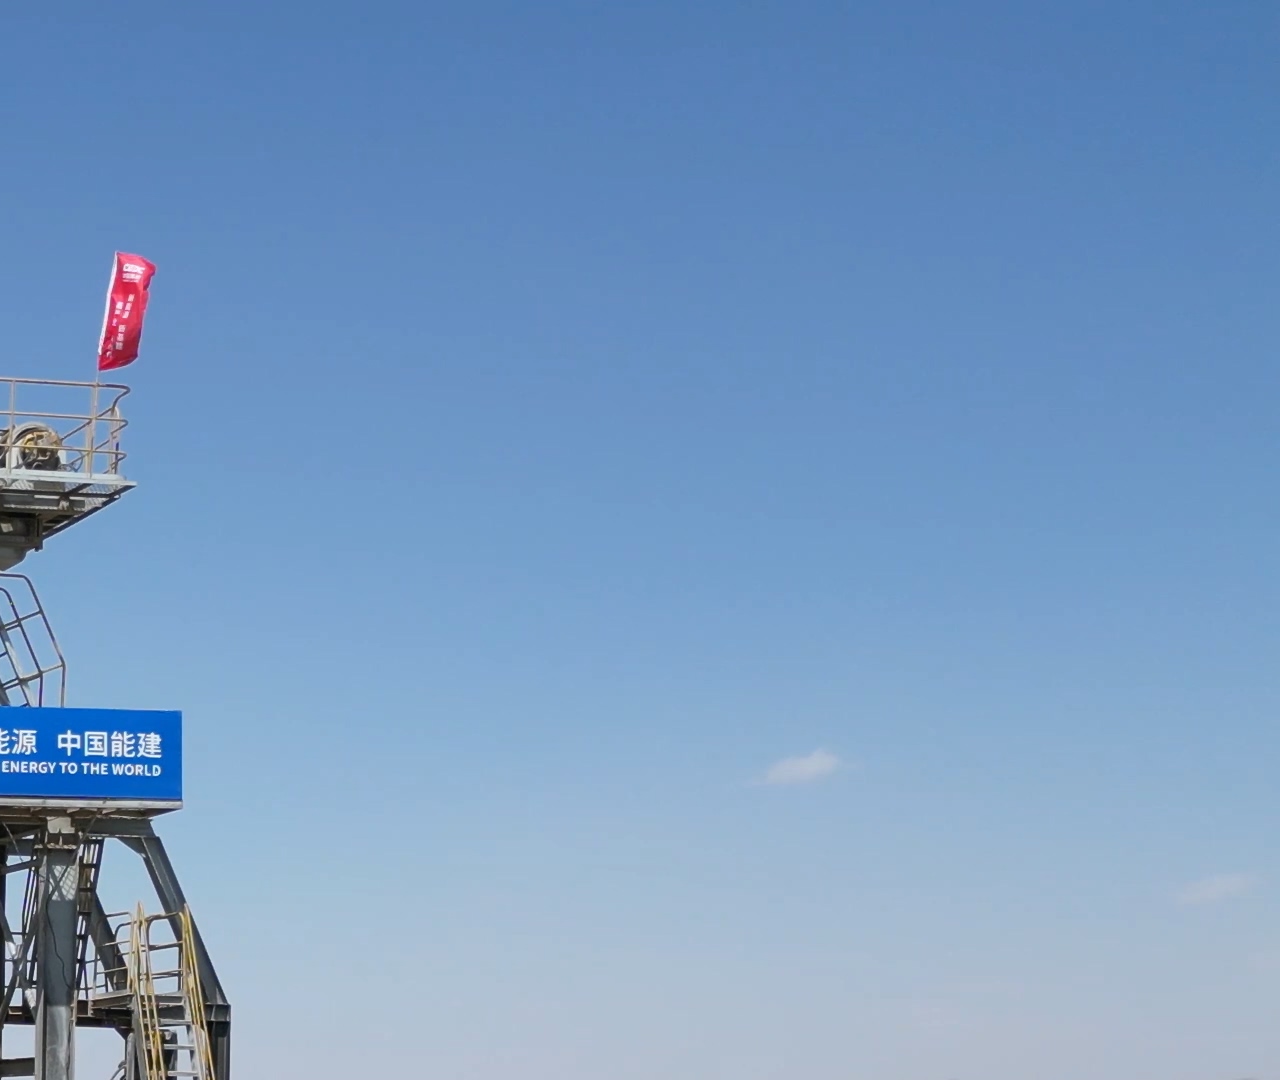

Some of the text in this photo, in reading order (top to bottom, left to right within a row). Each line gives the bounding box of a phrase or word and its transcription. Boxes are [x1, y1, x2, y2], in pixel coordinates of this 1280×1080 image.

[57, 729, 162, 759] 中国能建
[1, 760, 57, 774] ENERGY
[59, 761, 78, 775] TO
[81, 762, 109, 776] THE
[111, 763, 162, 777] WORLD
